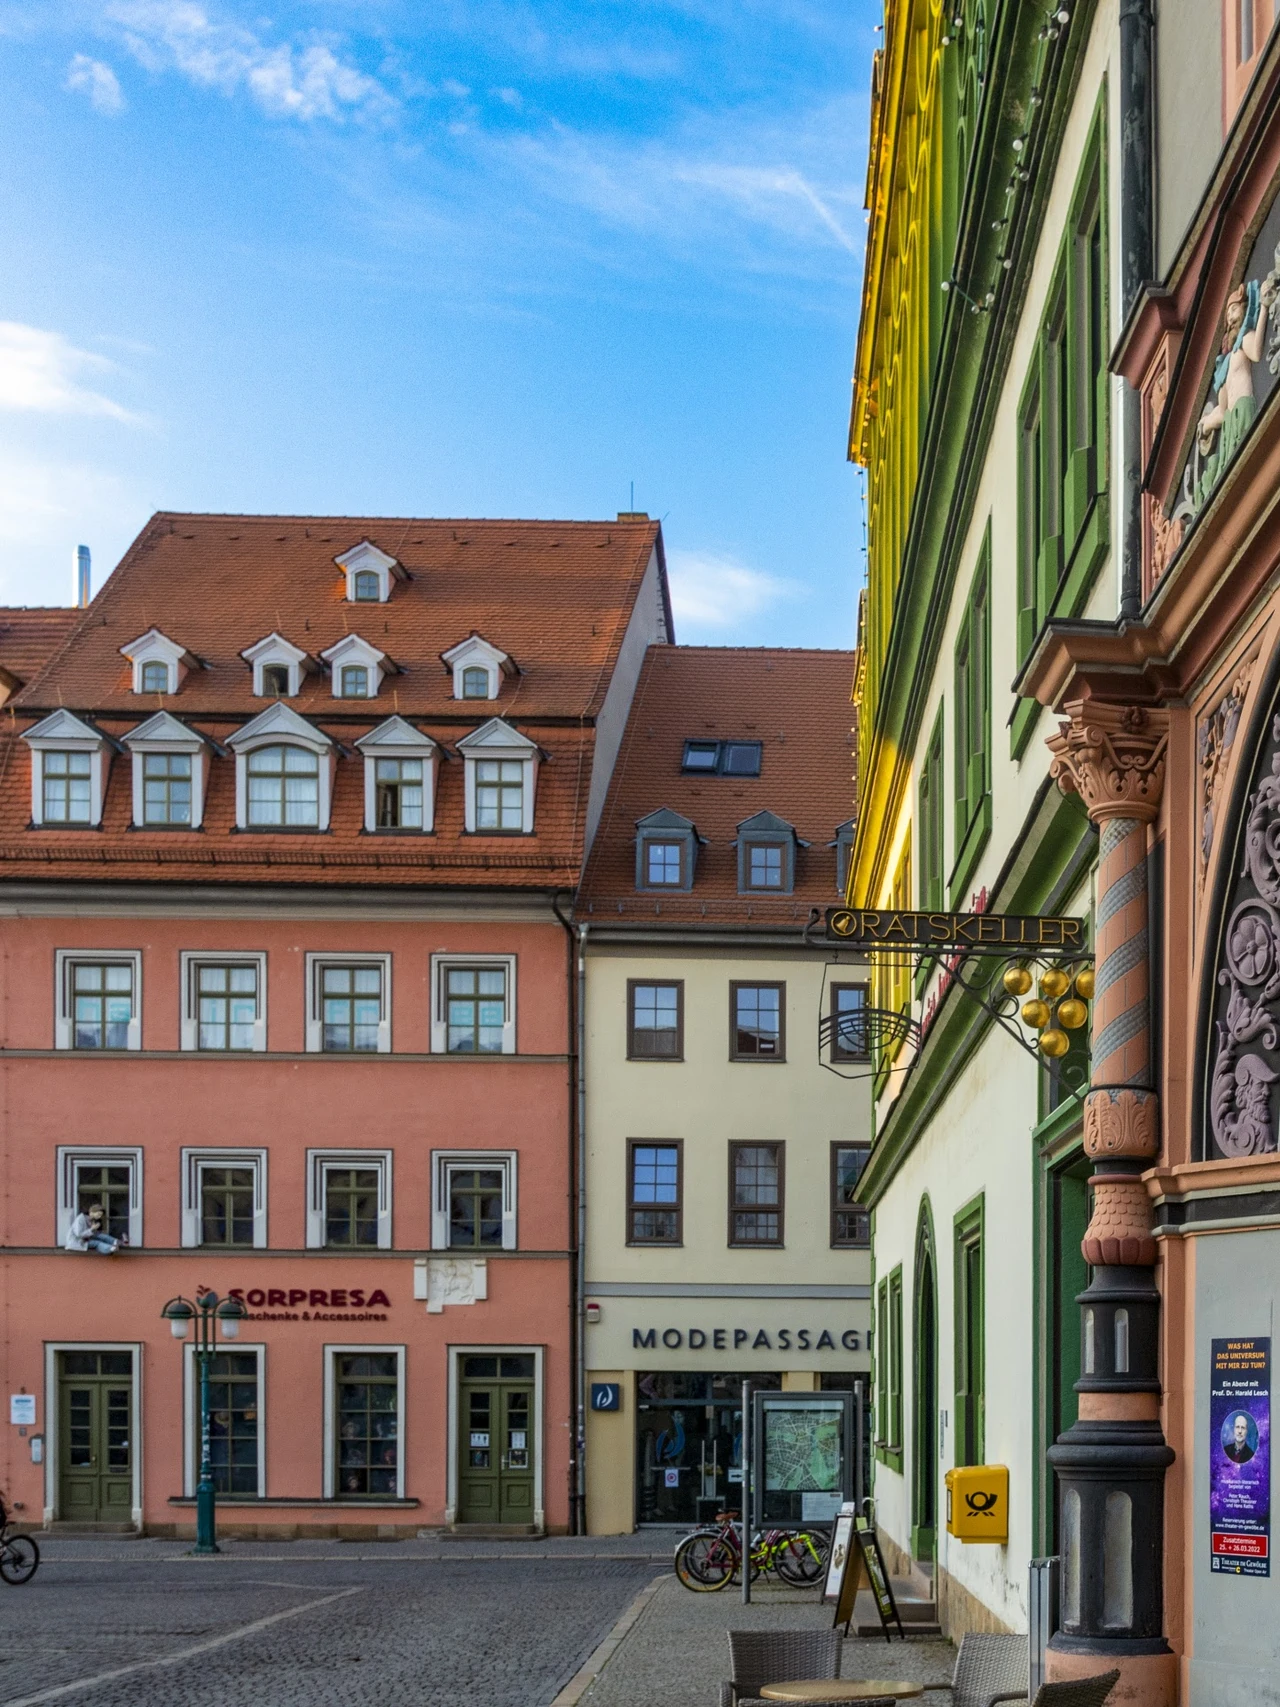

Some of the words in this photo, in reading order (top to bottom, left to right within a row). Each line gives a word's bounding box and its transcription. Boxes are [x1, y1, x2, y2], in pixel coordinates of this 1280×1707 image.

[860, 912, 1080, 945] RATSKELLER
[228, 1288, 392, 1309] SORPRESA
[301, 1311, 310, 1321] &
[313, 1311, 388, 1322] Accessoires
